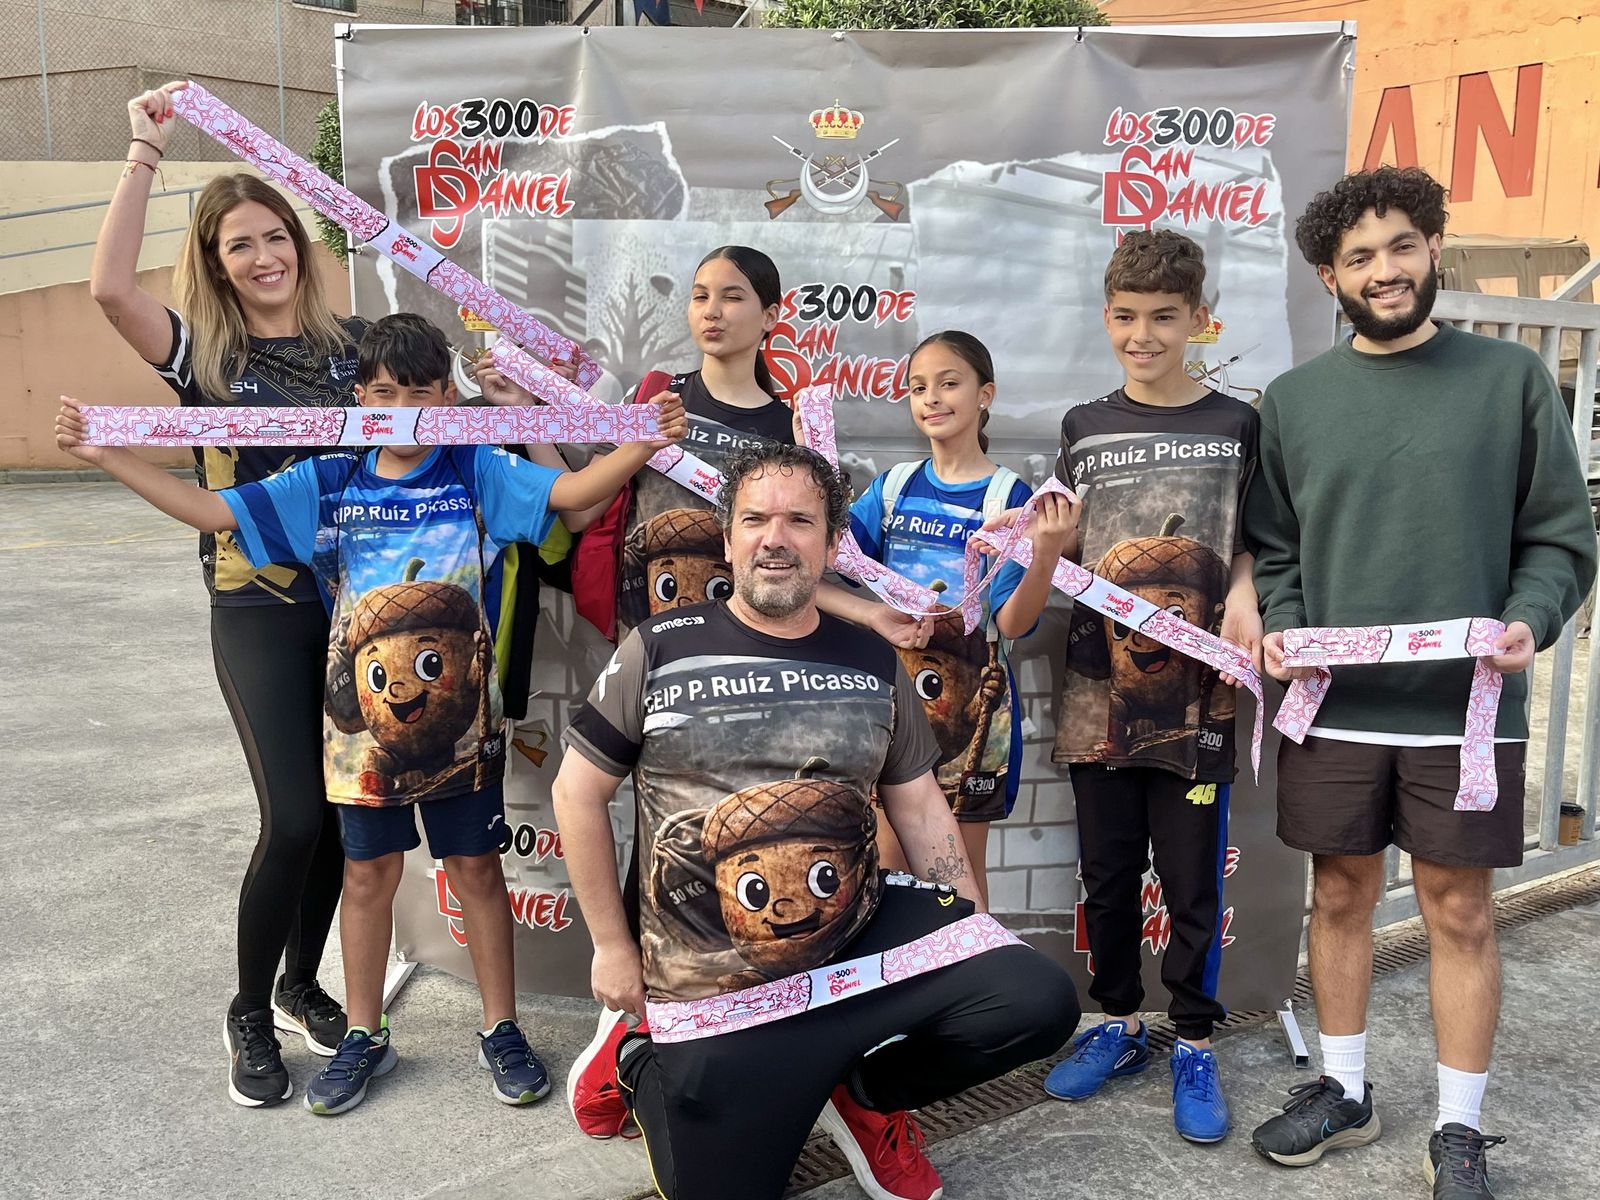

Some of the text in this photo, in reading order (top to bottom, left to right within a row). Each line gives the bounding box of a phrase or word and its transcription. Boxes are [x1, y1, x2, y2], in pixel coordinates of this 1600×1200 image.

[414, 166, 575, 219] DANIEL
[1102, 172, 1271, 227] DANIEL
[1086, 455, 1097, 473] P.
[1100, 445, 1147, 469] Ruíz
[368, 504, 411, 521] Ruíz
[908, 516, 946, 537] Ruíz
[1077, 621, 1097, 637] KG
[644, 684, 683, 713] CEIP
[688, 679, 707, 702] P.
[711, 670, 774, 697] Ruíz
[1199, 730, 1224, 748] 300
[976, 778, 996, 791] 300
[1185, 784, 1217, 805] 46
[668, 880, 708, 905] 30 KG
